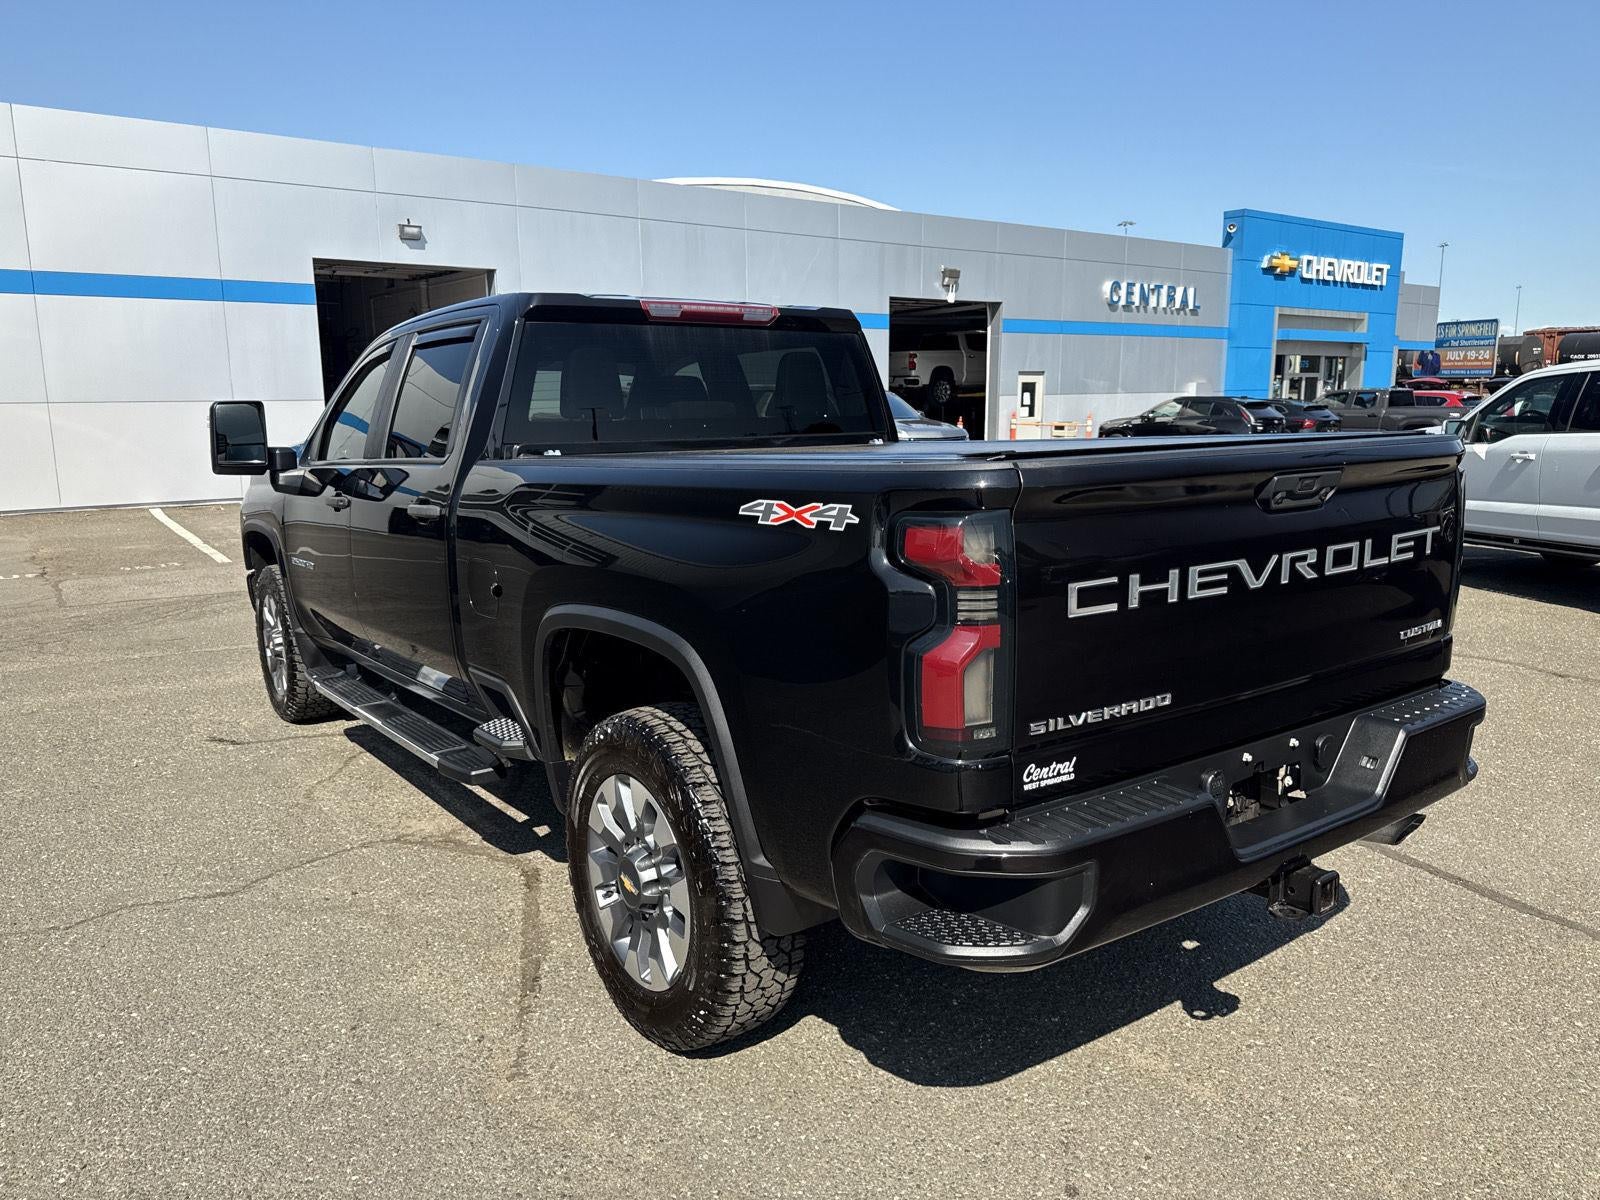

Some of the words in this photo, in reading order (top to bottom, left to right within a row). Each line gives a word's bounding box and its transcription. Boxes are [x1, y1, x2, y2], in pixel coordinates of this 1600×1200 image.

[1302, 254, 1390, 286] CHEVROLET
[1105, 279, 1201, 310] CENTRAL
[1445, 323, 1457, 338] FOR
[1457, 321, 1497, 338] SPRINGFIELD
[1446, 350, 1466, 361] JULY
[1466, 350, 1490, 360] 19-24
[1067, 525, 1441, 619] CHEVROLET
[1029, 692, 1172, 736] SILVERADO
[1022, 756, 1077, 783] Central
[1023, 781, 1040, 791] WEST
[1040, 773, 1075, 787] SPRINGFIELD
